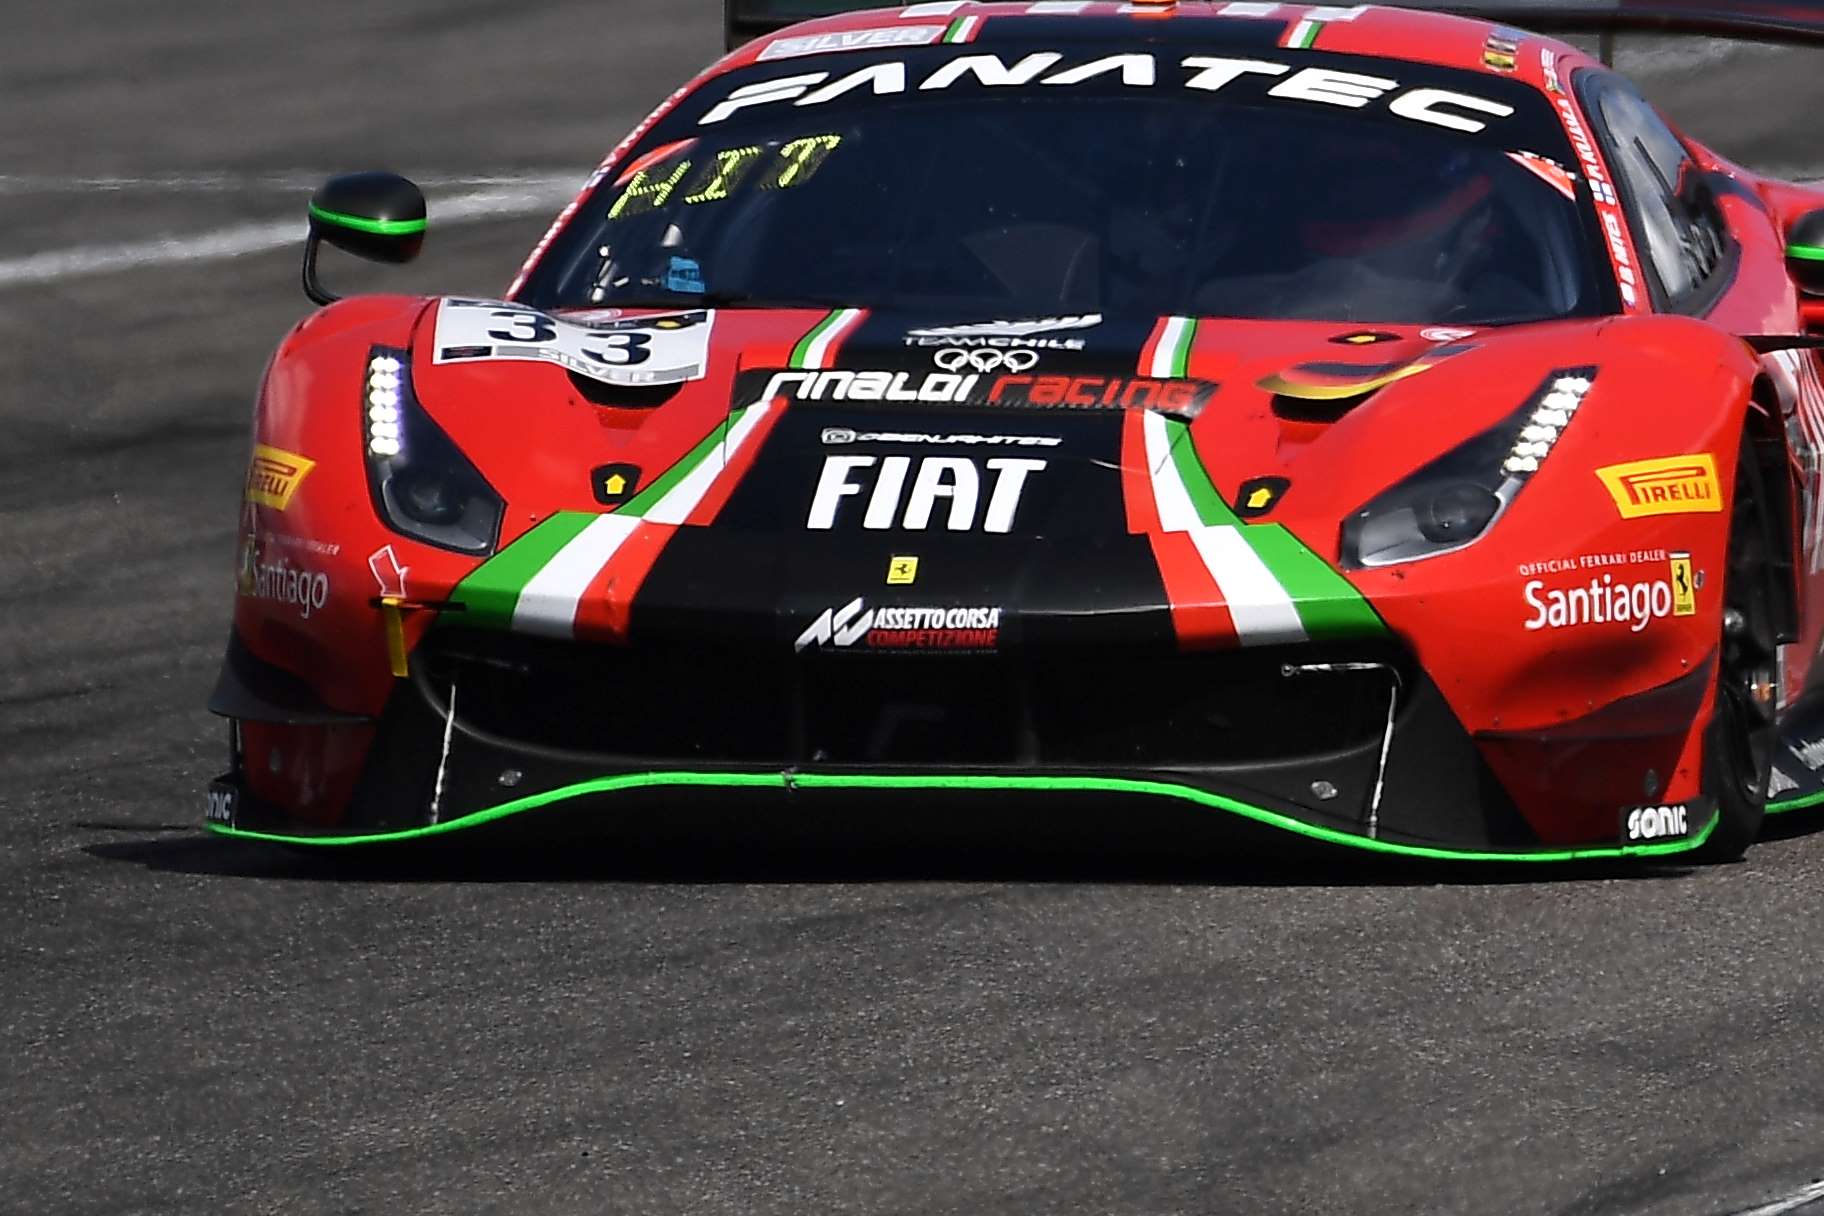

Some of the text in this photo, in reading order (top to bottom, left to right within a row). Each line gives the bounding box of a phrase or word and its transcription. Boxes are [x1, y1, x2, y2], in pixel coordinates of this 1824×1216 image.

[775, 30, 932, 55] SILVER
[698, 53, 1514, 133] FANATEC
[608, 135, 842, 218] HIT
[537, 346, 655, 383] SILVER
[806, 454, 1047, 533] FIAT
[1619, 466, 1711, 506] PIRELLI
[1519, 548, 1667, 576] OFFICIAL FERRARI DEALER
[873, 606, 1002, 630] ASSETTO CORSA
[1524, 573, 1672, 632] Santiago
[866, 630, 998, 648] COMPETIZIONE
